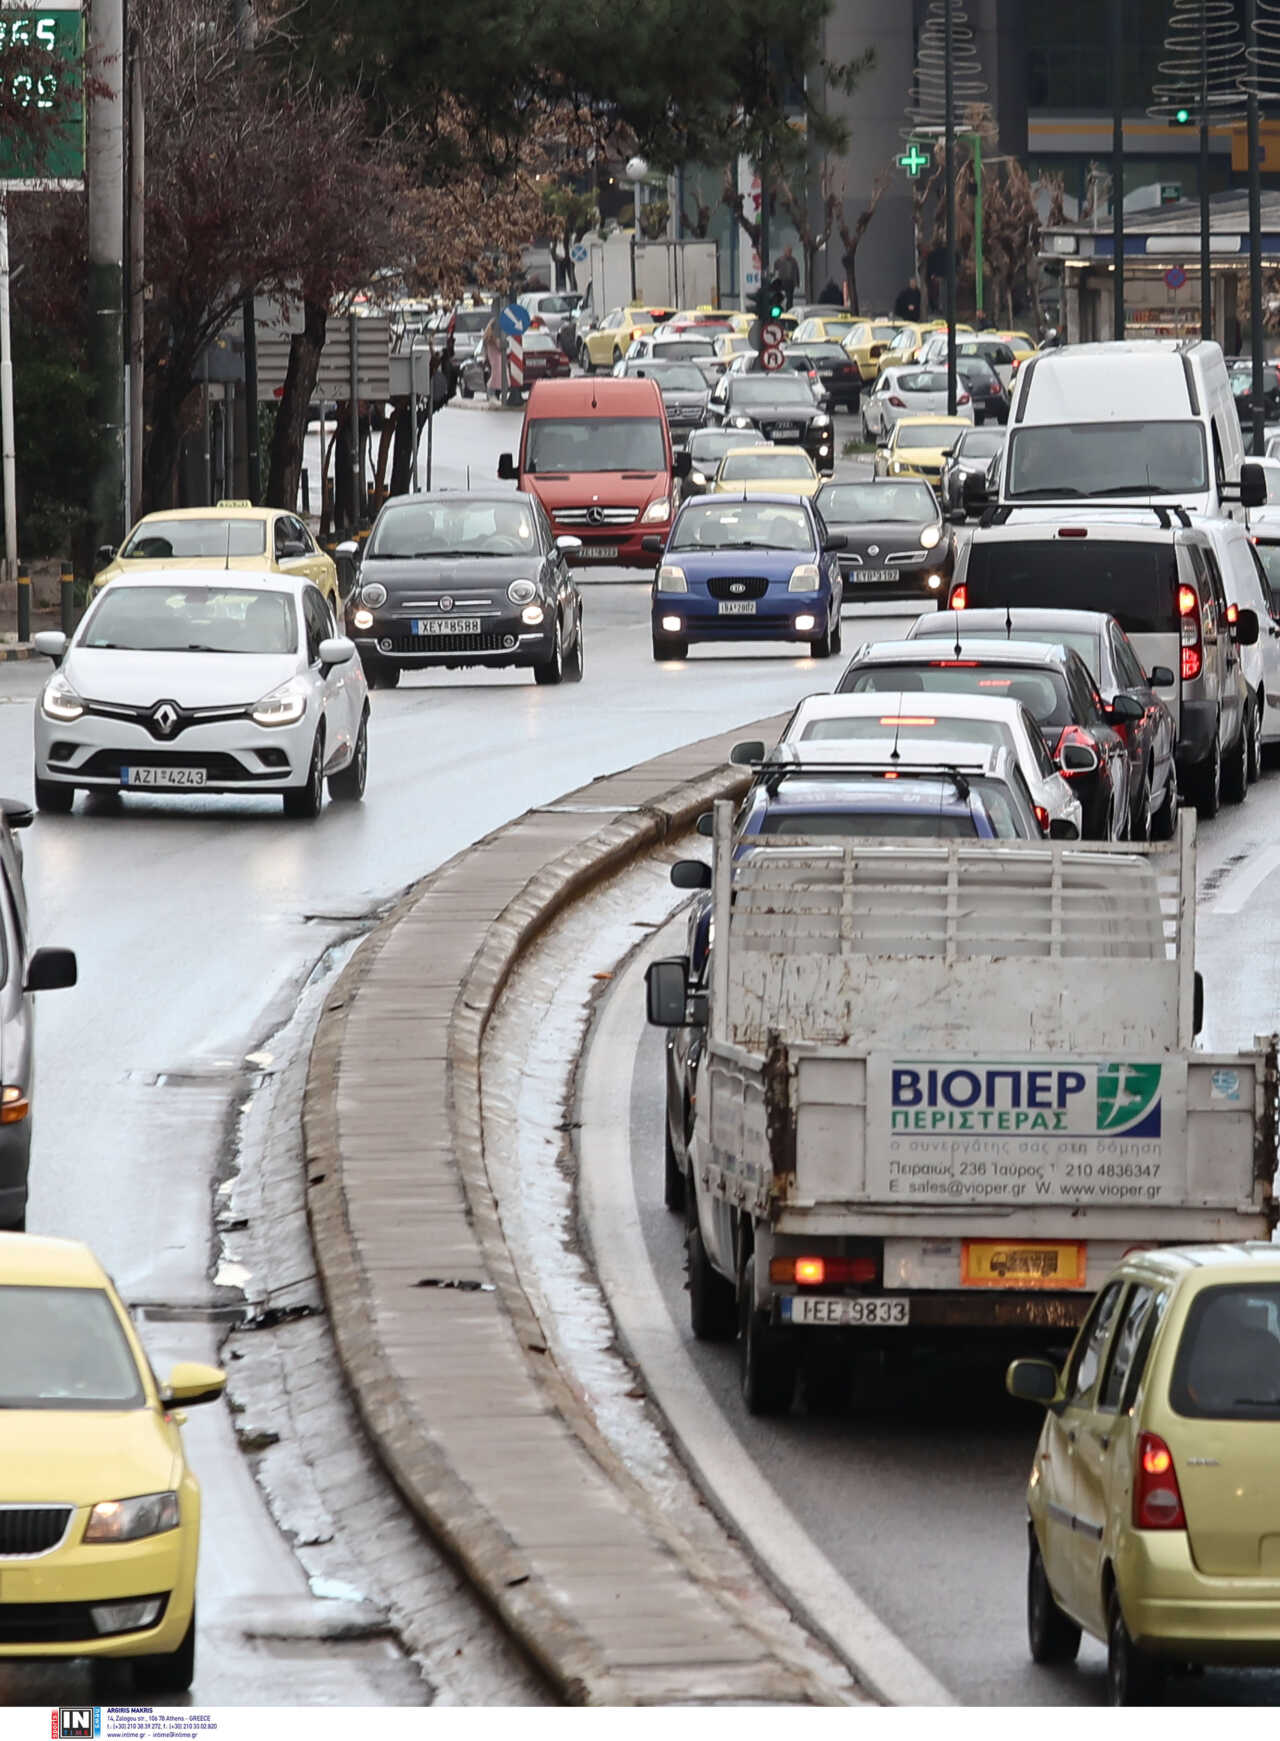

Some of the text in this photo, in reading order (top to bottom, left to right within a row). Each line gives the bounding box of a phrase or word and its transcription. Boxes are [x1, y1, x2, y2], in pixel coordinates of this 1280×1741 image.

[422, 621, 443, 633] XEY
[134, 769, 204, 785] AZI 4243
[891, 1069, 1086, 1108] ΒΙΟΠΕΡ
[891, 1110, 1069, 1131] ΠΕΡΙΣΤΕΡΑΣ
[959, 1162, 987, 1175] 236
[1065, 1163, 1093, 1177] 210
[1097, 1164, 1161, 1178] 4836347
[908, 1180, 1026, 1197] sales@vioper.gr
[1060, 1183, 1162, 1198] www.vioper.gr
[852, 1301, 907, 1323] 9833
